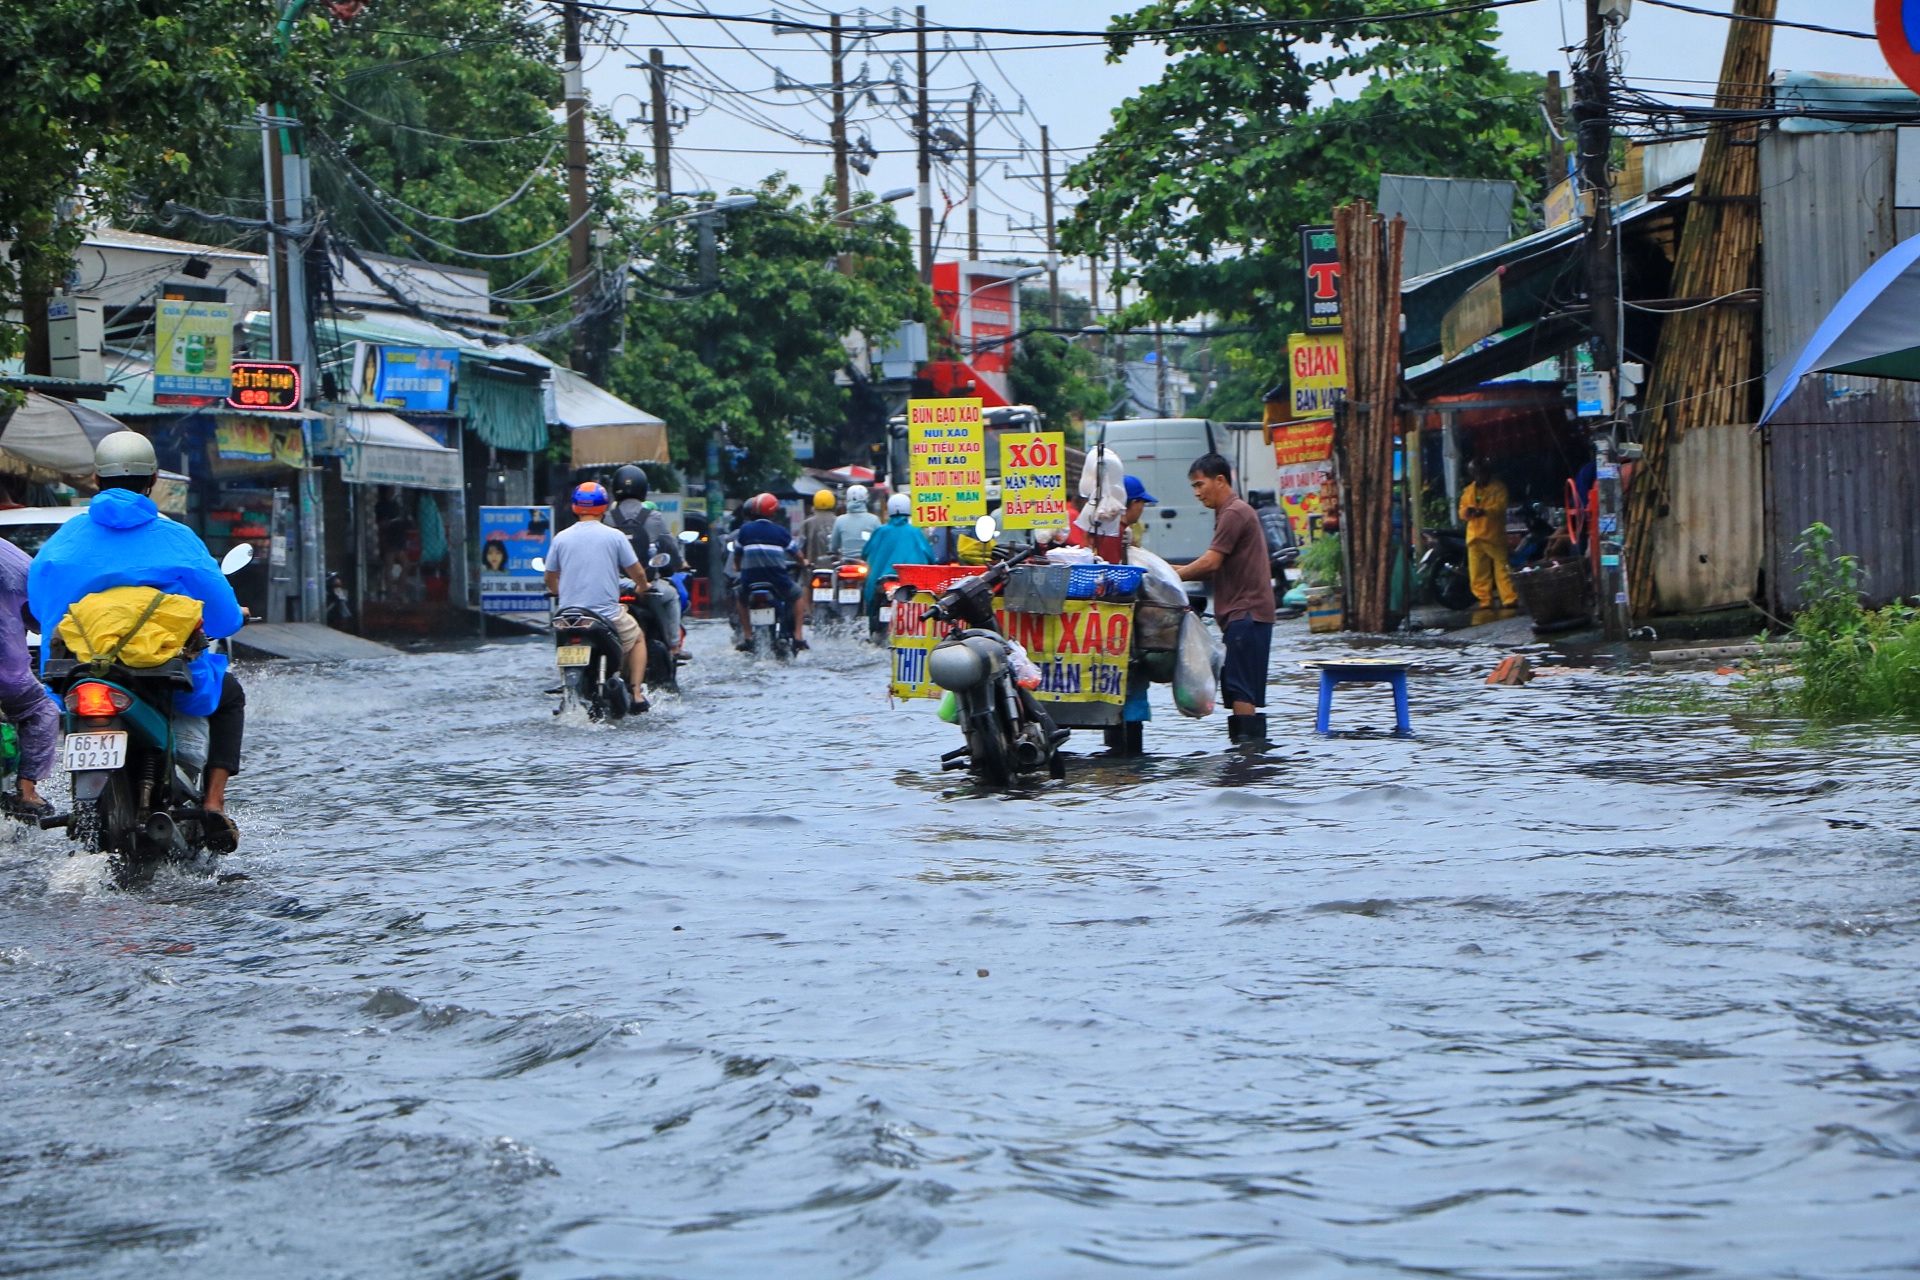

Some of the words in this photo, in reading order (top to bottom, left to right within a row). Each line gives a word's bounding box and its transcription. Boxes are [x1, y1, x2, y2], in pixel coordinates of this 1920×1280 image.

[1294, 338, 1339, 378] GIÀN
[913, 405, 933, 423] BÚN
[937, 407, 956, 426] GẠO
[959, 404, 978, 422] XÀO
[924, 429, 943, 438] NUI
[1009, 437, 1058, 467] XÔI
[1005, 473, 1027, 492] MẶN
[1034, 475, 1062, 491] NGỌT
[918, 492, 943, 502] CHAY
[956, 490, 979, 503] MẶN
[1006, 495, 1031, 514] BẮP
[1057, 603, 1128, 656] XÀO
[897, 648, 927, 691] THỊT
[75, 735, 115, 751] 66-K1
[68, 751, 118, 768] 192.31
